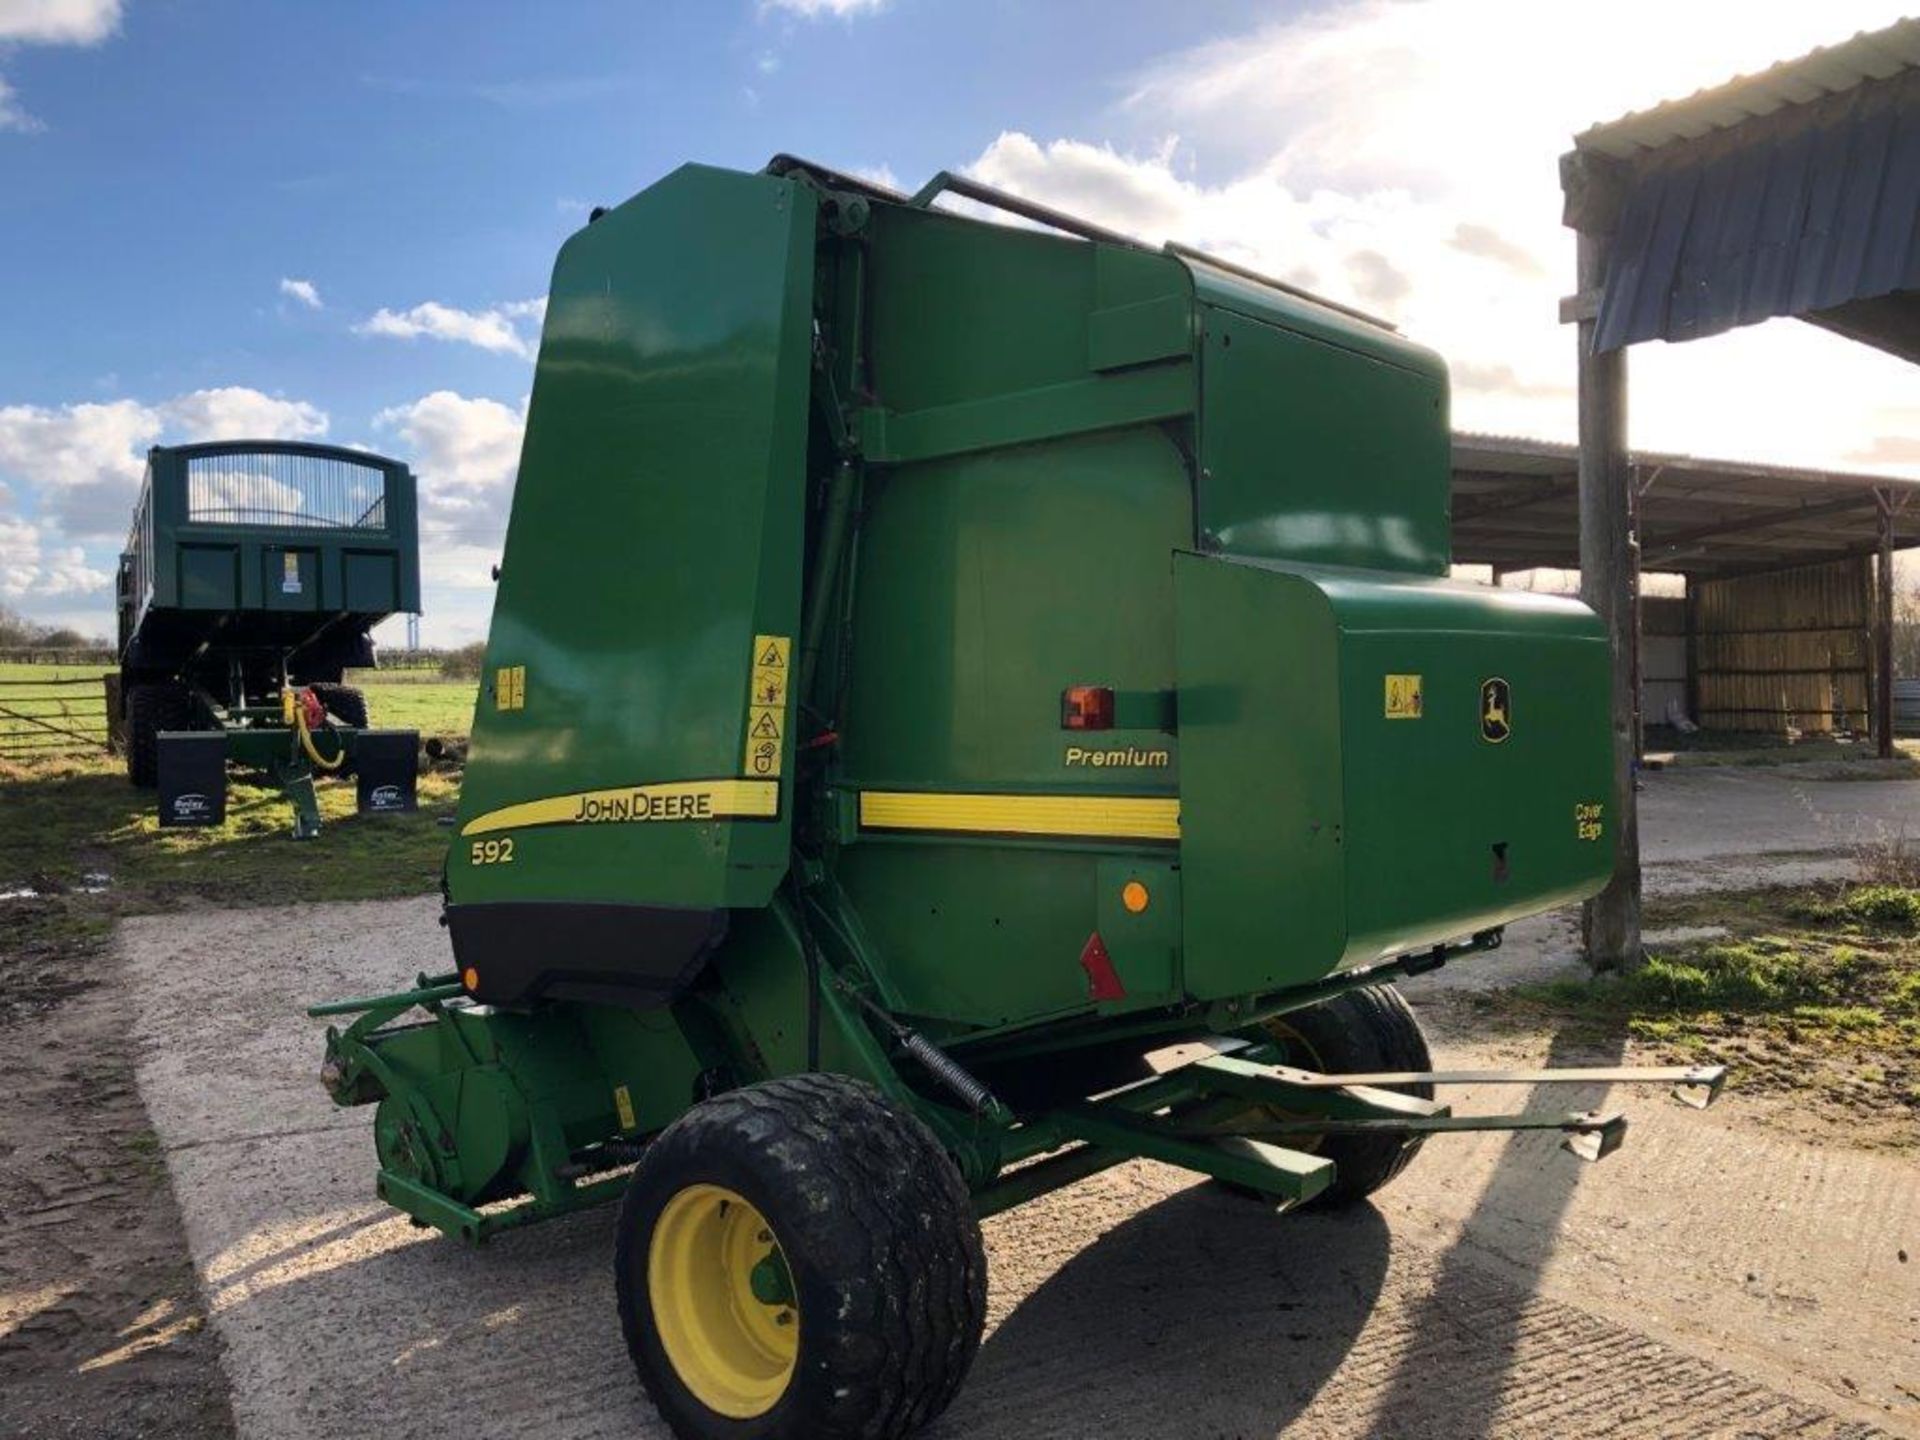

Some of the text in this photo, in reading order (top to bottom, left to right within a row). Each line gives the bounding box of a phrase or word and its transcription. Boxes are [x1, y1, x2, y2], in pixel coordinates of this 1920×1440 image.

[1065, 747, 1168, 767] Premium
[575, 793, 712, 820] JOHN DEERE
[471, 838, 514, 865] 592
